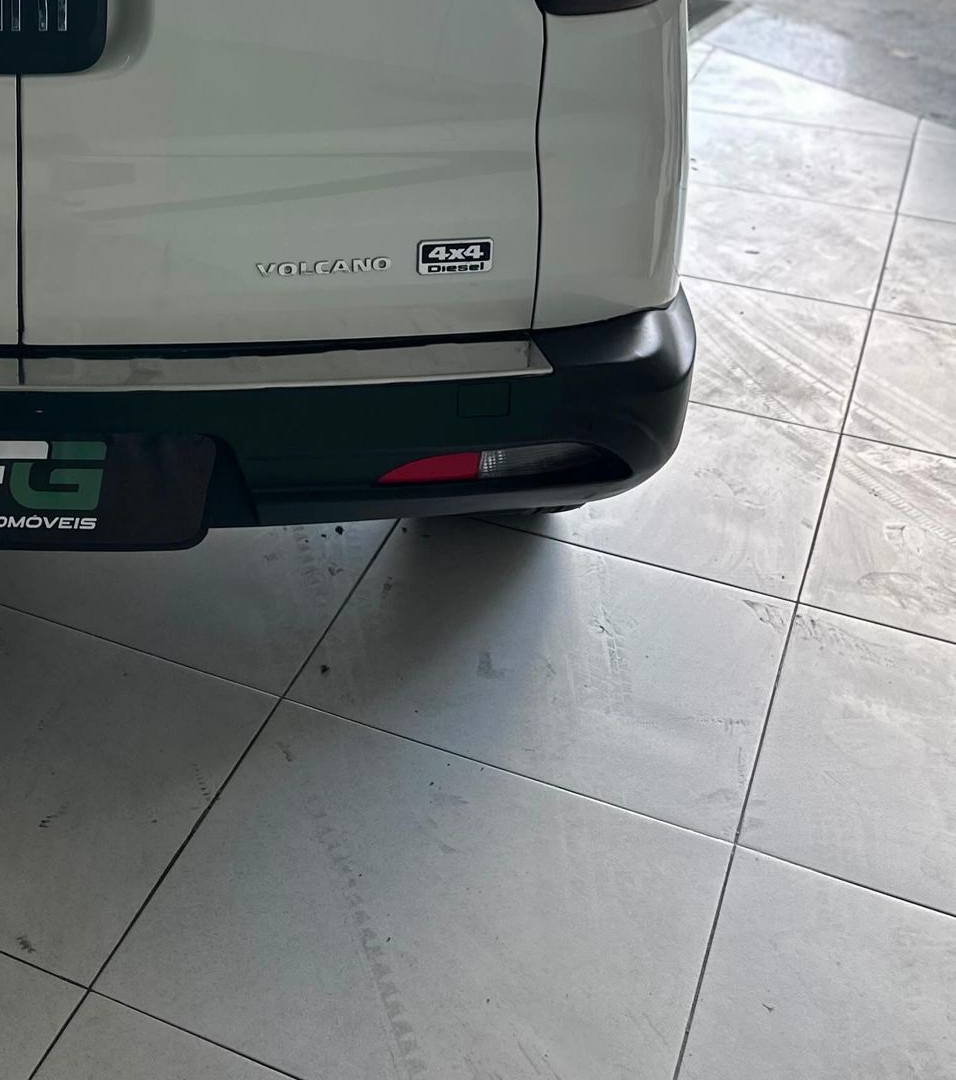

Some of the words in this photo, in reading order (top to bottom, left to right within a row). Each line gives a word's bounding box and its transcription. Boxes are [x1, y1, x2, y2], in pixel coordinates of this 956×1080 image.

[428, 244, 484, 261] 4x4
[256, 257, 392, 278] VOLCANO
[428, 263, 484, 273] Diesel
